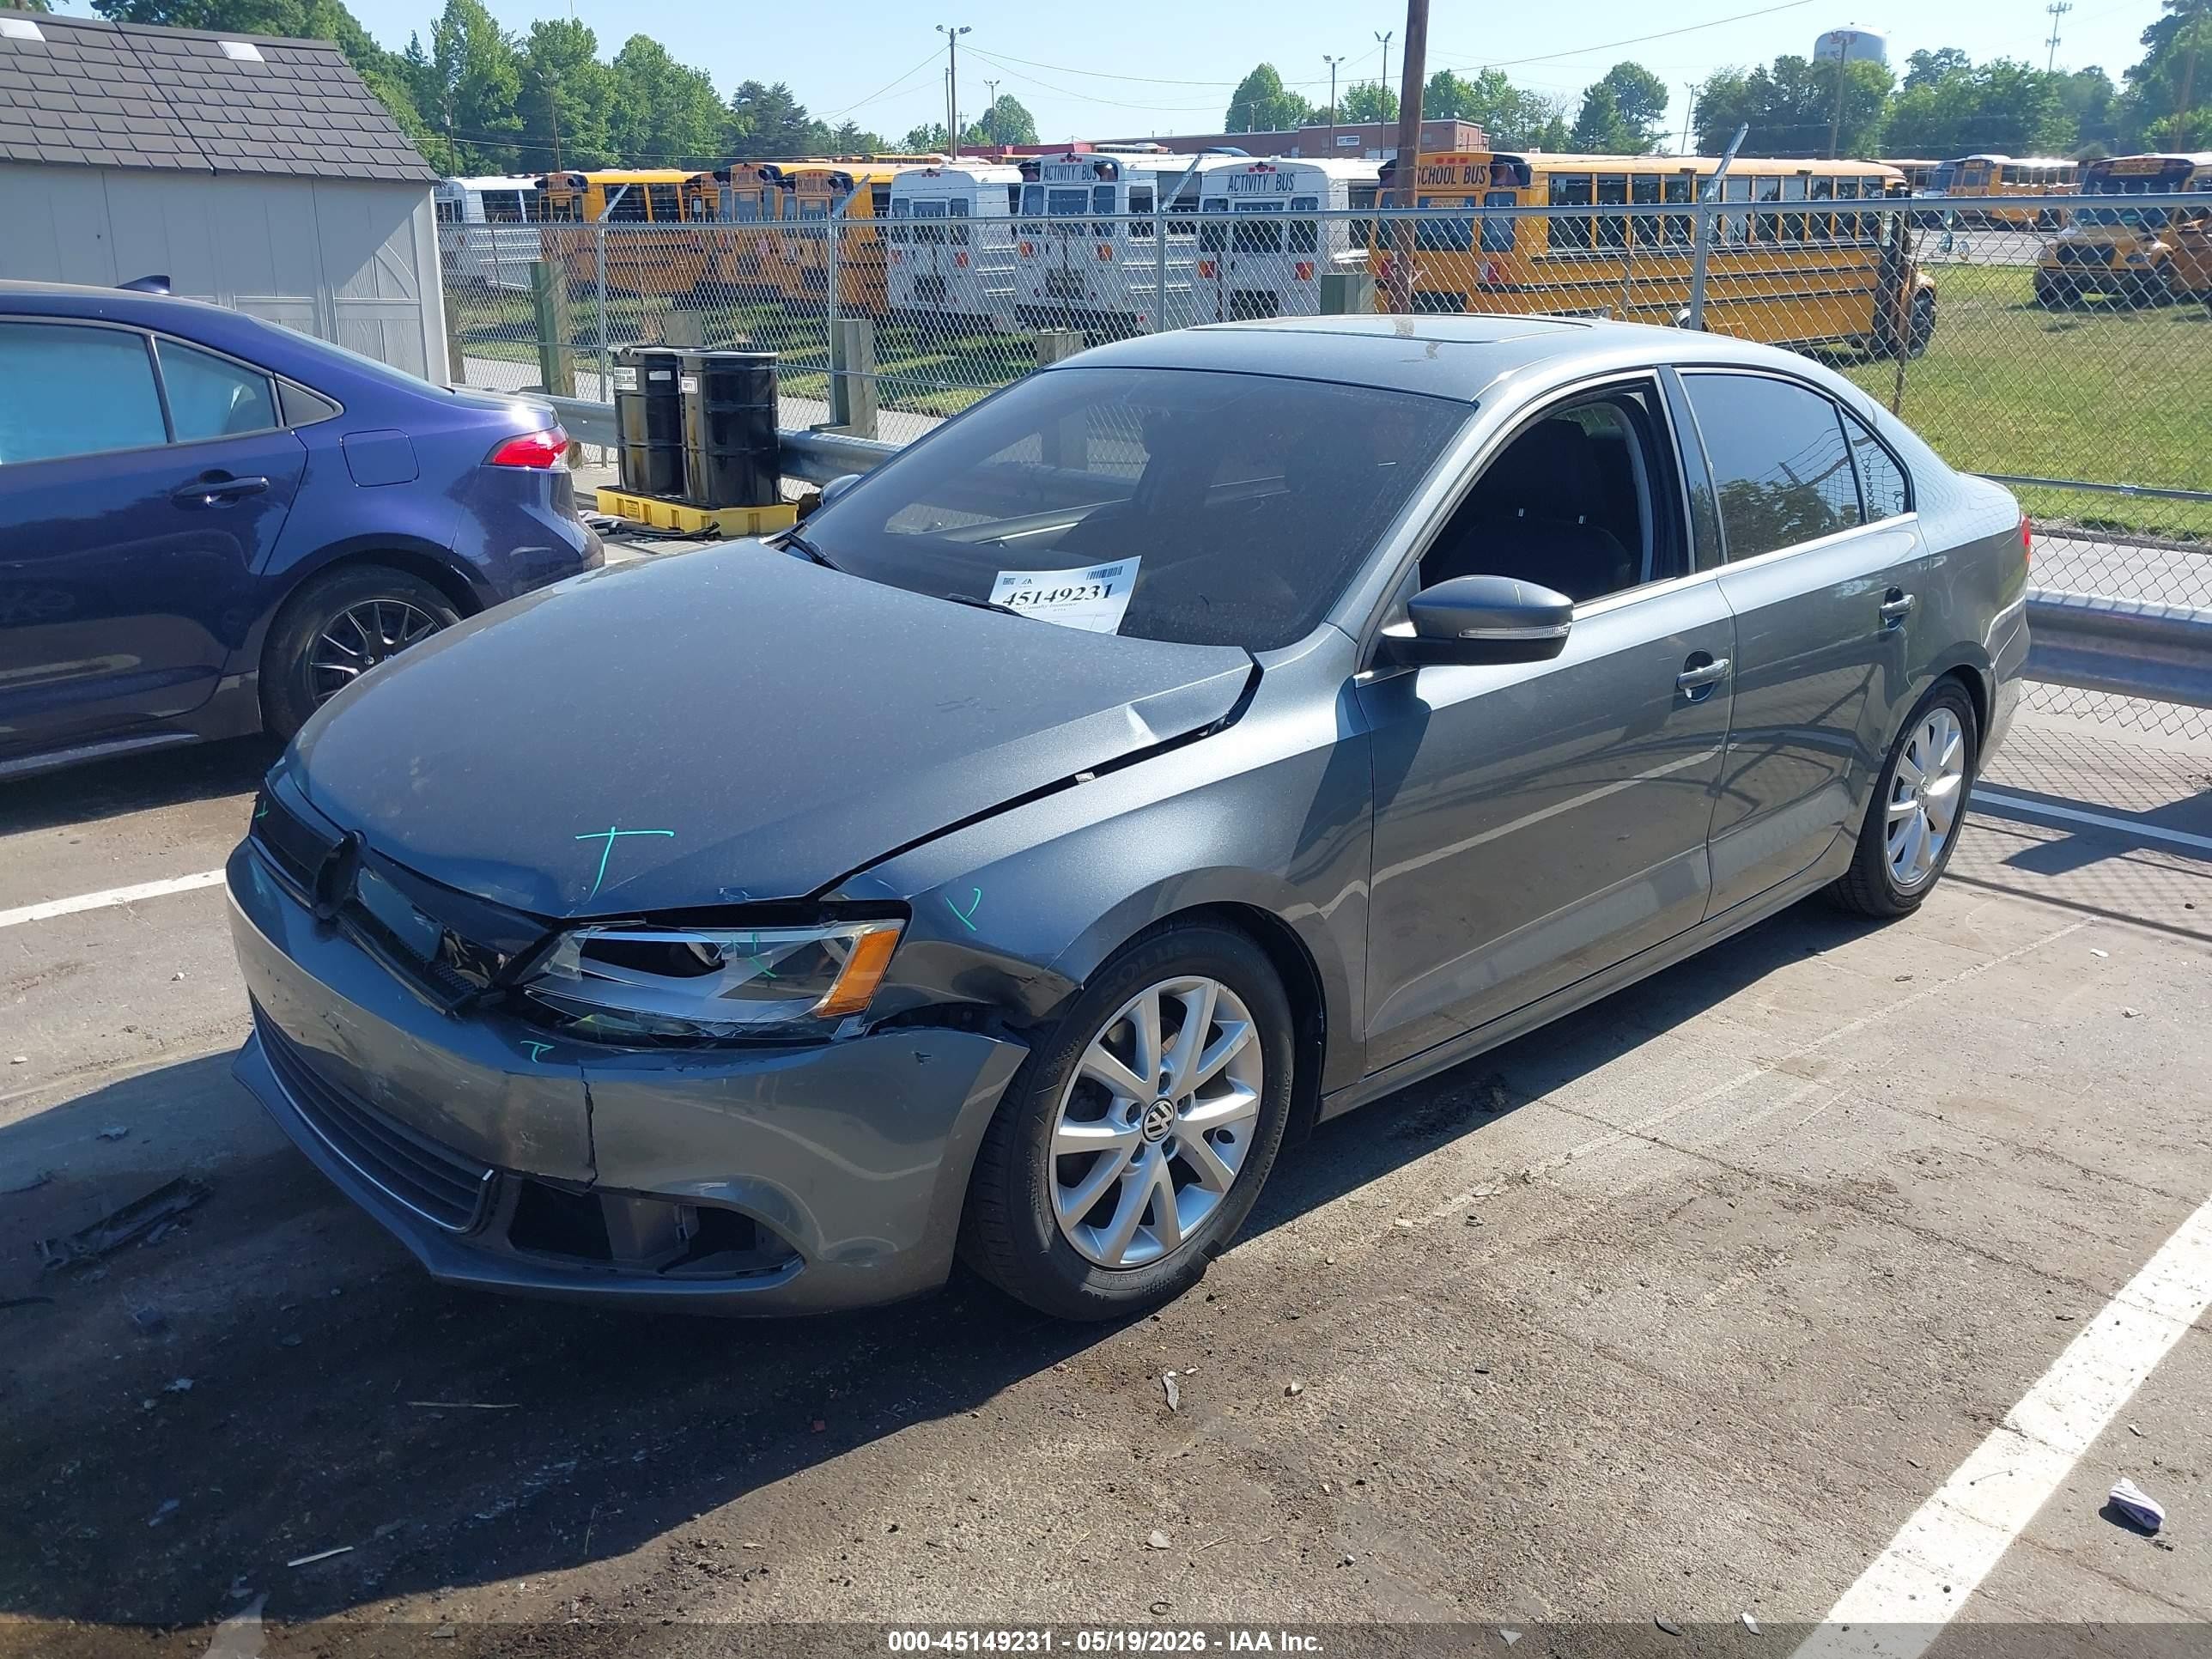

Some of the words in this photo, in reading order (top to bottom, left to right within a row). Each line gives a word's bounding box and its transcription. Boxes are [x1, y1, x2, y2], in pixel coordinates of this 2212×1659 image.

[1043, 164, 1078, 181] ACTIVITY
[1082, 163, 1097, 180] BUS
[1463, 165, 1487, 185] BUS
[1227, 173, 1269, 192] ACTIVITY
[1275, 173, 1295, 191] BUS
[1002, 583, 1113, 606] 45149231
